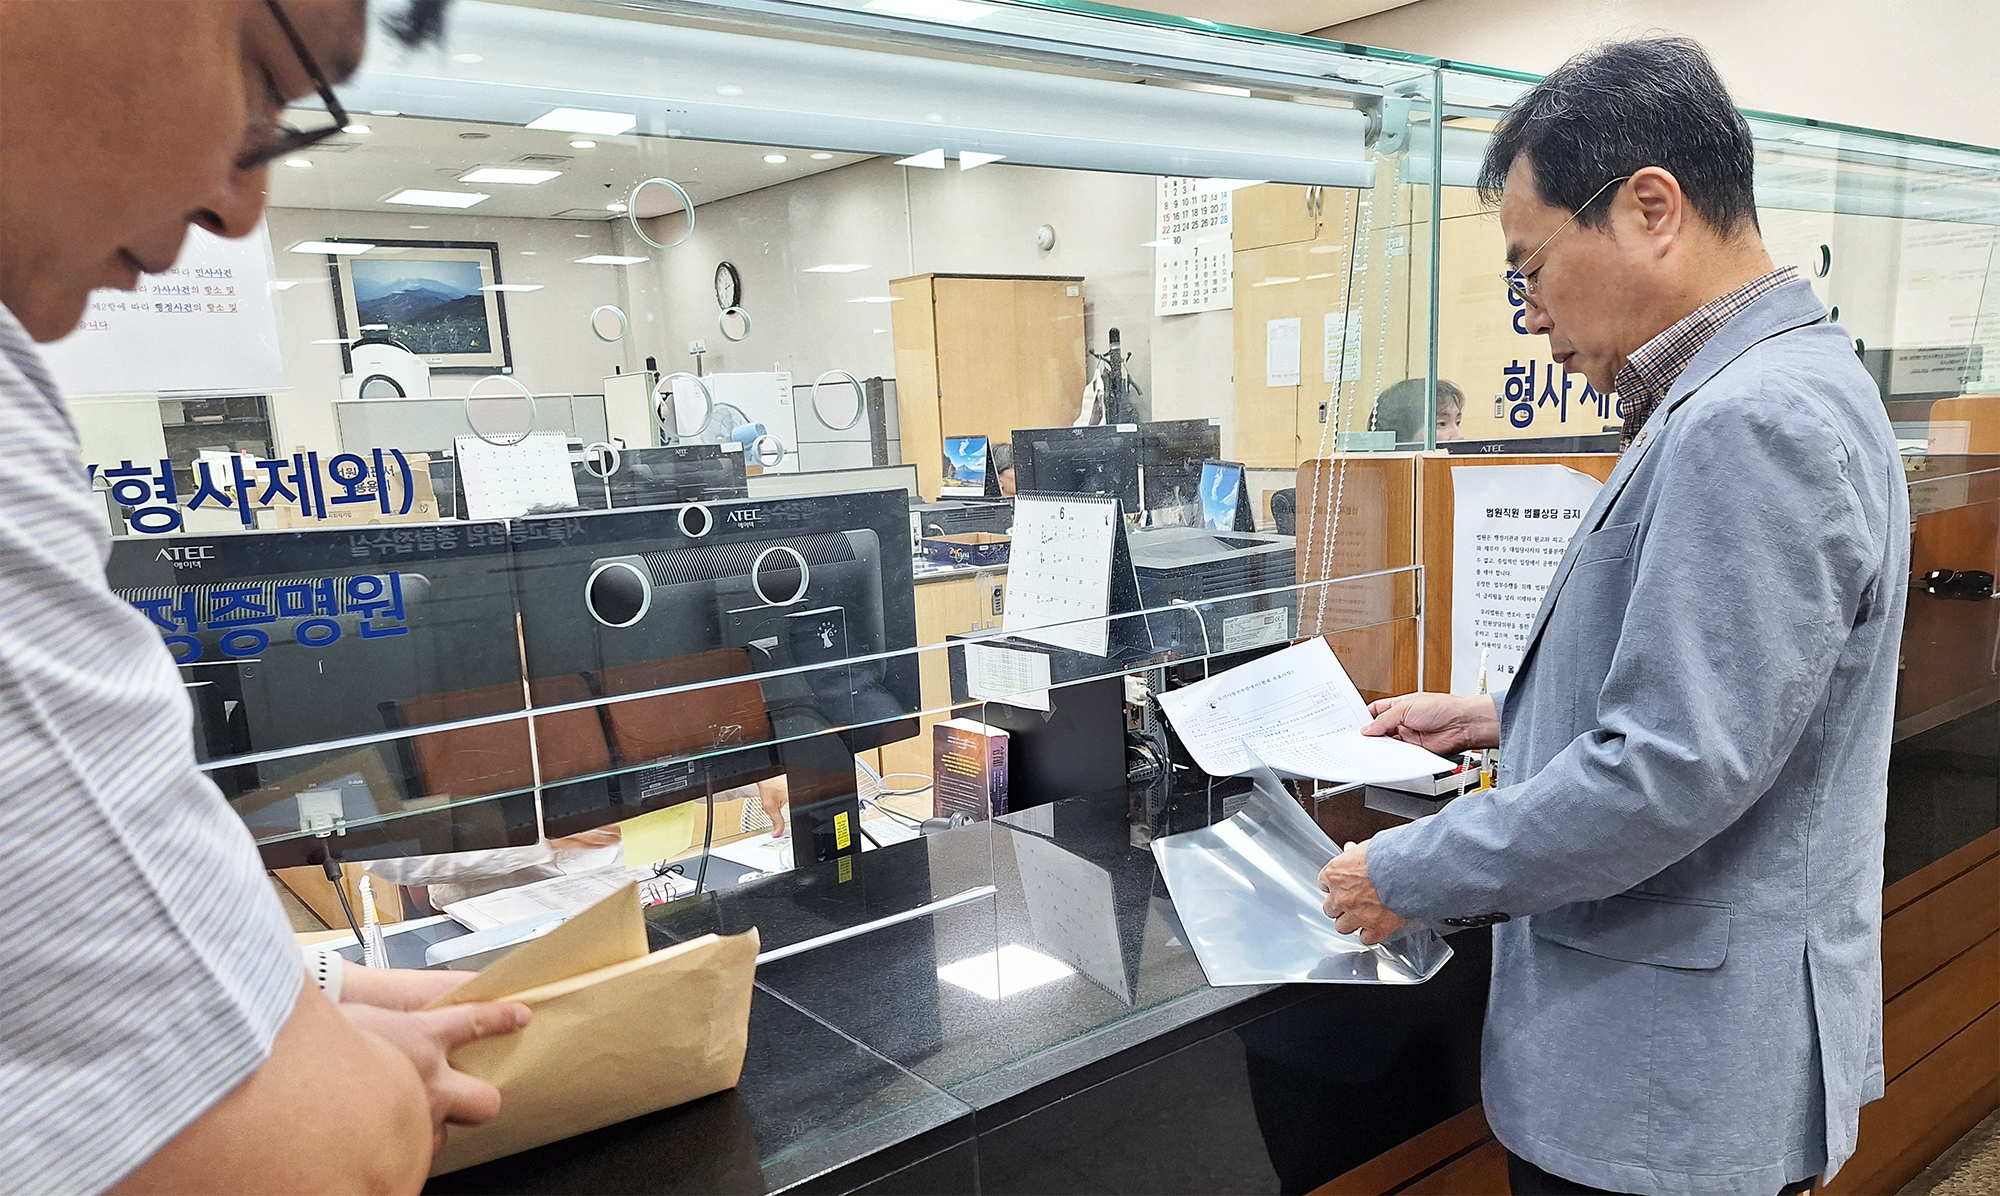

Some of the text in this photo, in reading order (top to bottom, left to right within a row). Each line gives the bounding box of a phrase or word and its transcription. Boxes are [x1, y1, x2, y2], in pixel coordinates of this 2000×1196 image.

[1174, 188, 1177, 196] 2
[1183, 186, 1186, 194] 3
[1164, 202, 1168, 210] 8
[1174, 200, 1178, 208] 9
[1183, 198, 1189, 206] 10
[1163, 214, 1170, 222] 15
[1173, 212, 1180, 220] 16
[1183, 210, 1188, 218] 17
[1201, 207, 1207, 215] 19
[1211, 205, 1218, 213] 20
[1221, 203, 1227, 211] 21
[1163, 215, 1228, 234] 22 23 24 25 26 27 28
[1194, 247, 1198, 256] 7
[1504, 360, 1572, 428] 형사
[88, 448, 413, 534] (형사제외)
[727, 509, 761, 522] ATEC
[1486, 508, 1580, 519] 법원직원 법률상담 금지
[155, 546, 215, 561] ATEC
[174, 561, 201, 569] 에이텍
